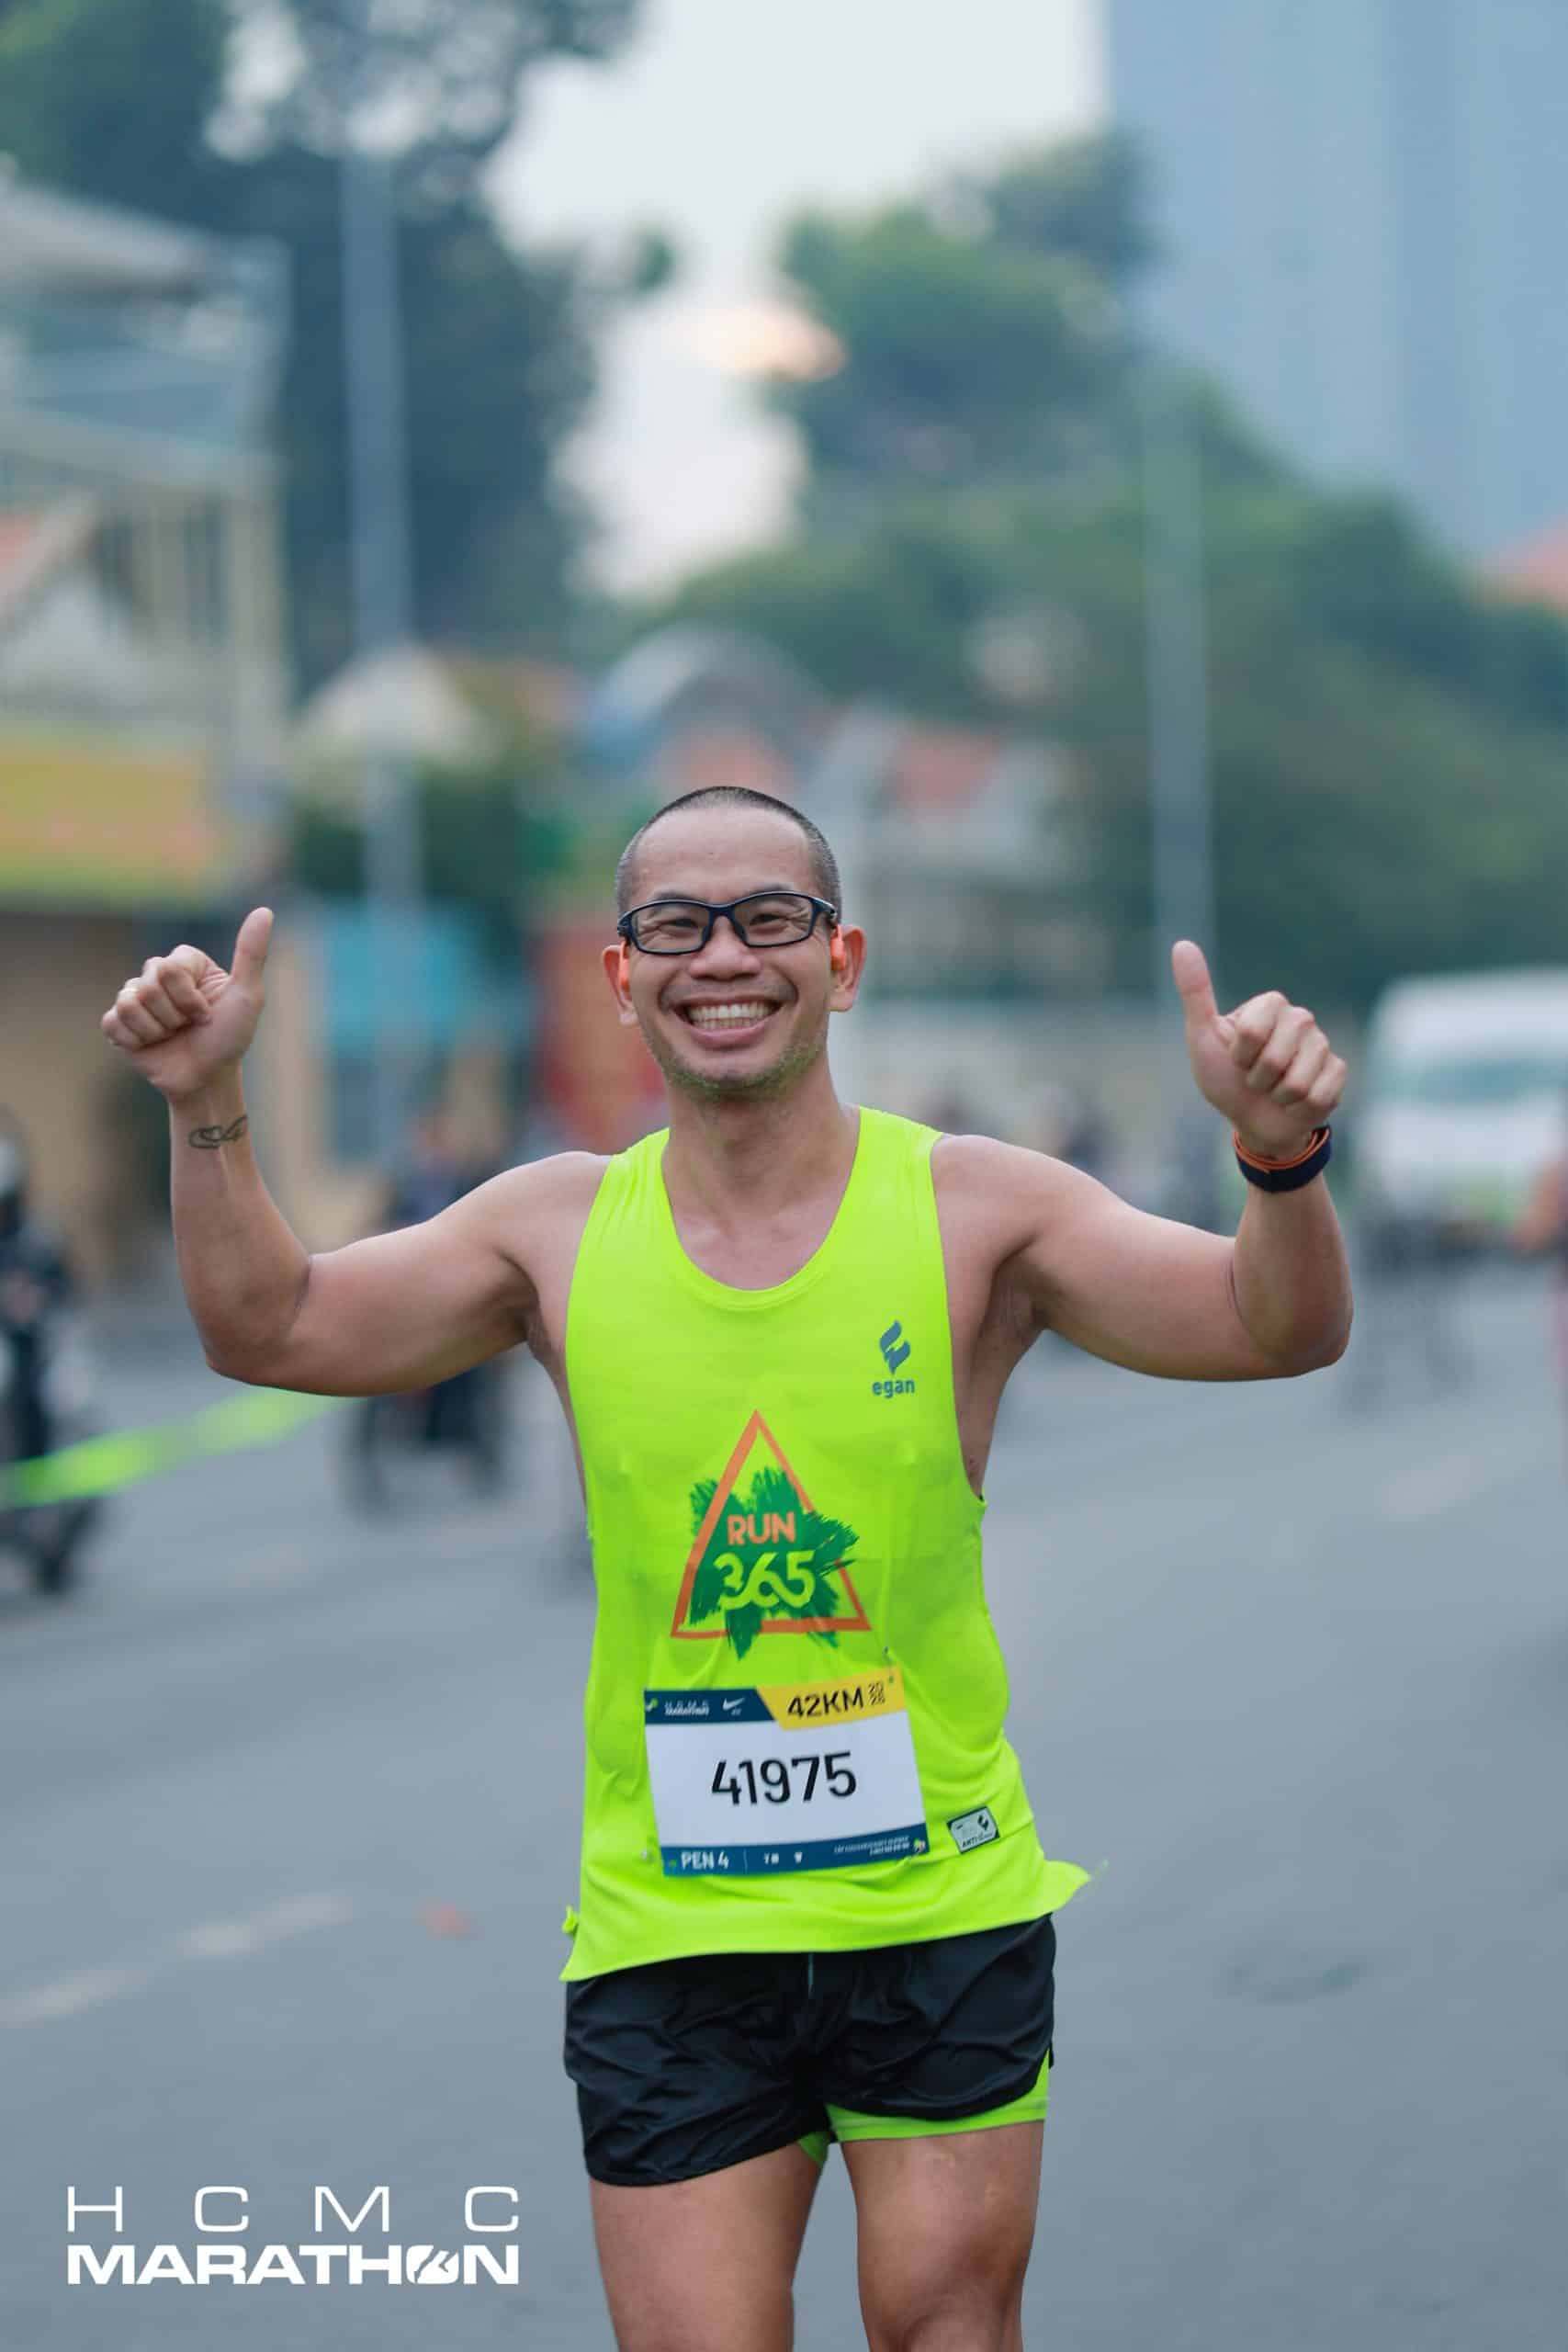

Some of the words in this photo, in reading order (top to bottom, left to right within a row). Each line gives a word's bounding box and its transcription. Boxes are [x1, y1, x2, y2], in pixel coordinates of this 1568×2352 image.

[872, 1379, 916, 1398] egan
[727, 1511, 796, 1545] RUN
[713, 1550, 816, 1610] 365
[787, 1686, 864, 1718] 42KM
[711, 1751, 857, 1805] 41975
[681, 1850, 715, 1870] PEN
[717, 1850, 729, 1870] 4
